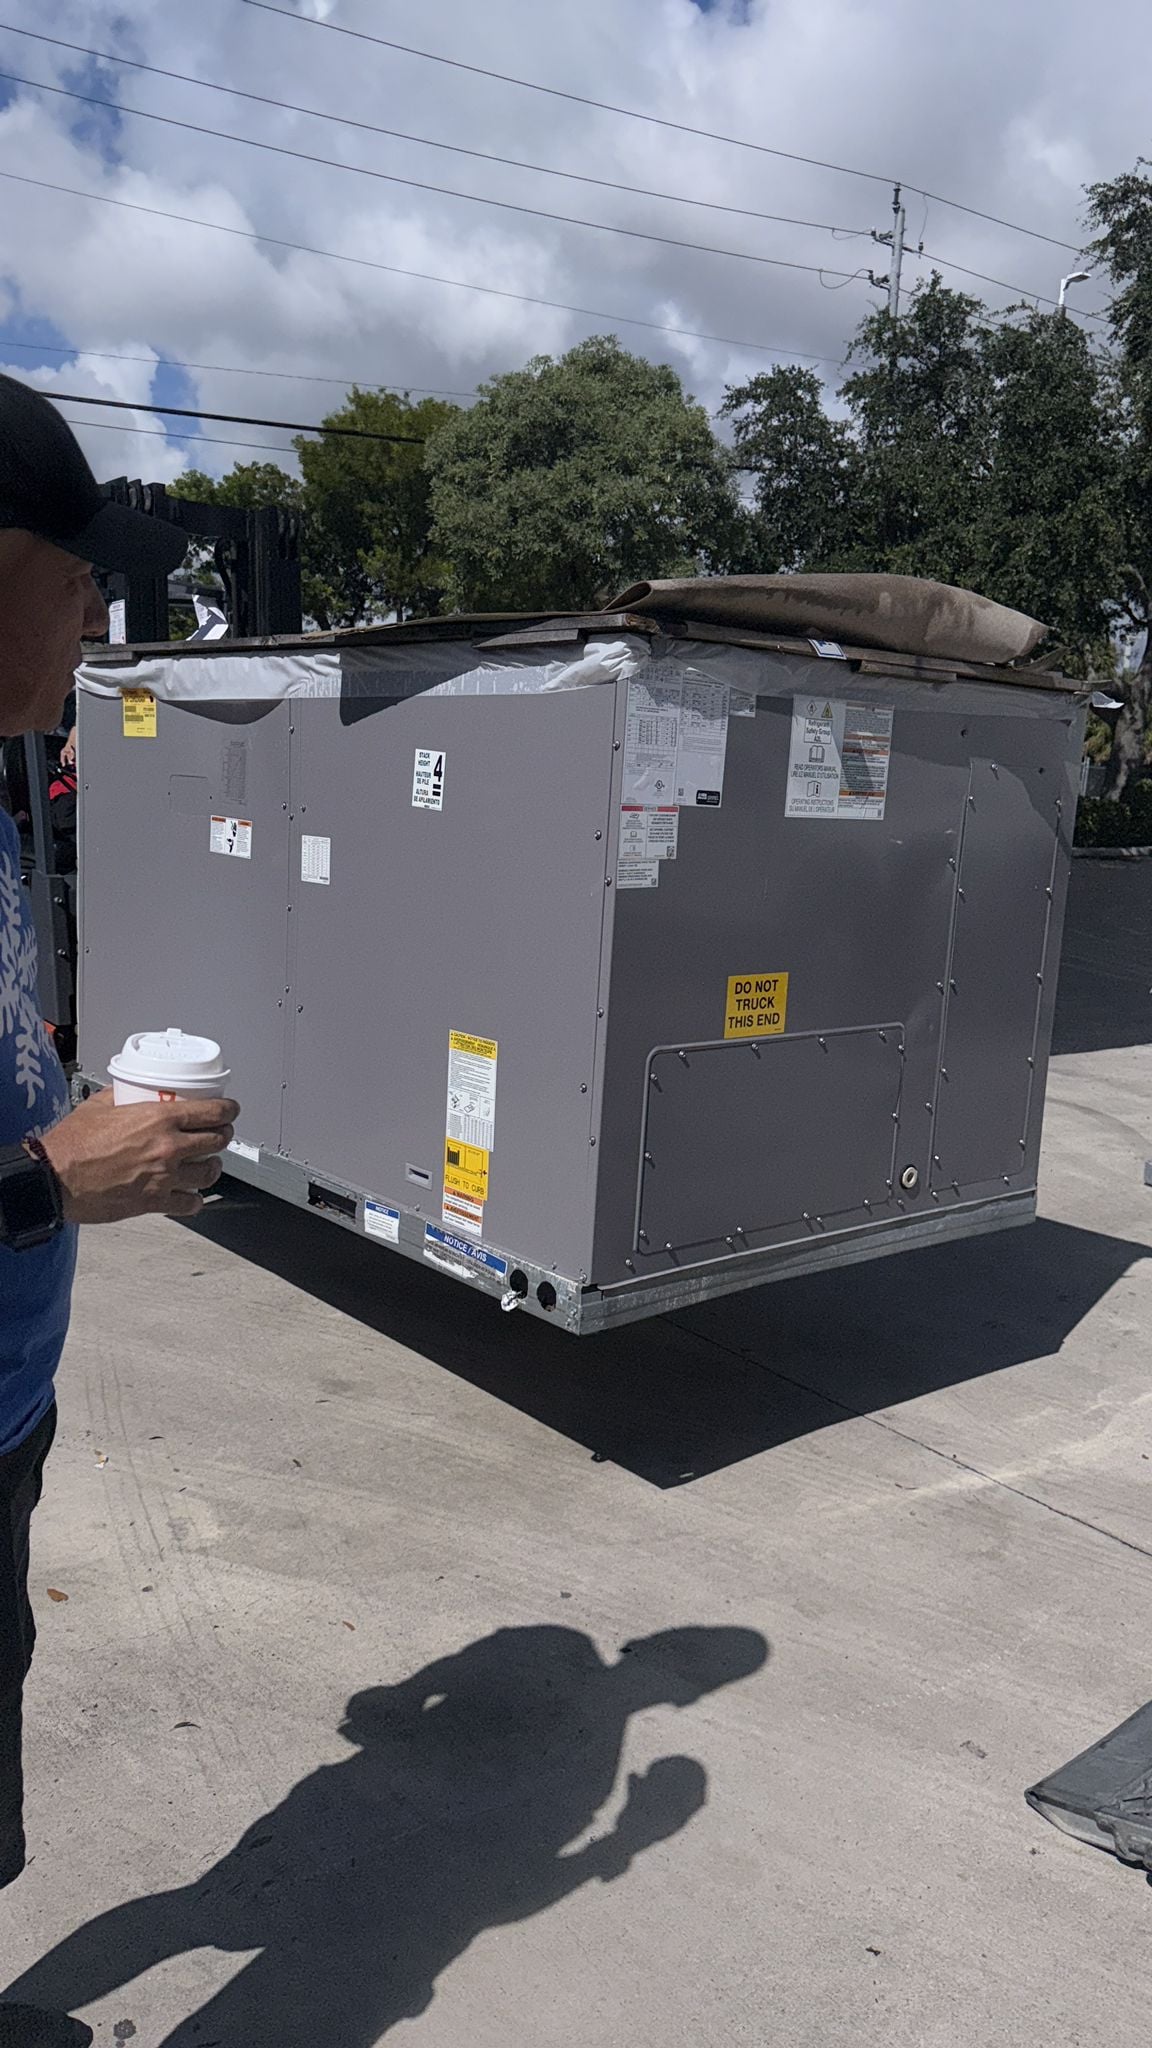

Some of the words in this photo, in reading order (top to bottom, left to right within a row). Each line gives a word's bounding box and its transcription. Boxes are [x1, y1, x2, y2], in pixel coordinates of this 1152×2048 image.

[434, 755, 442, 782] 4
[735, 981, 752, 994] DO
[755, 979, 779, 993] NOT
[736, 996, 775, 1011] TRUCK
[728, 1015, 754, 1028] THIS
[757, 1013, 780, 1026] END
[445, 1174, 460, 1184] FLUSH
[462, 1179, 469, 1189] TO
[471, 1184, 484, 1195] CURB
[444, 1234, 468, 1253] NOTICE
[467, 1247, 472, 1255] /
[471, 1248, 487, 1262] AVIS
